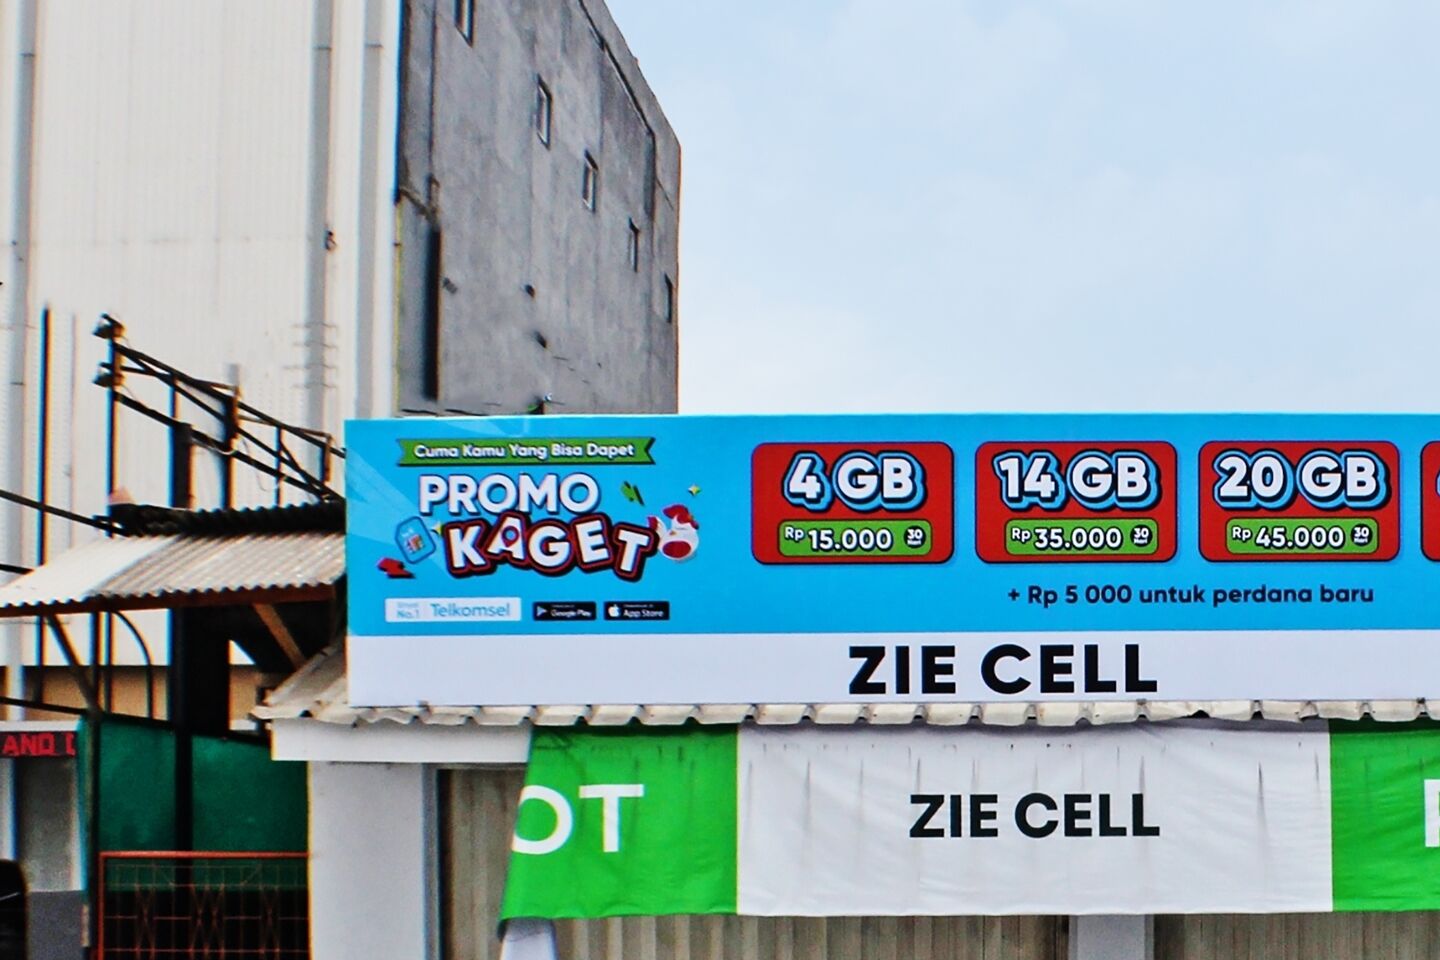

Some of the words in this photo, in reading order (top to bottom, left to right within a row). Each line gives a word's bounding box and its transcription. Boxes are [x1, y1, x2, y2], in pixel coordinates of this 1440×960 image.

[415, 444, 459, 458] Cuma
[463, 444, 505, 458] Kamu
[509, 443, 548, 460] Yang
[552, 443, 583, 457] Bisa
[587, 443, 634, 459] Dapet
[788, 457, 822, 499] 4
[836, 457, 914, 499] GB
[998, 457, 1057, 498] 14
[1071, 457, 1148, 498] GB
[1219, 456, 1285, 497] 20
[1301, 457, 1378, 497] GB
[418, 473, 600, 514] PROMO
[784, 526, 804, 542] Rp
[809, 528, 893, 550] 15.000
[906, 527, 923, 539] 30
[1012, 526, 1031, 542] Rp
[1035, 528, 1122, 550] 35.000
[1133, 527, 1150, 538] 30
[1232, 526, 1251, 542] Rp
[1255, 527, 1345, 548] 45.000
[1353, 526, 1369, 537] 30
[449, 515, 651, 573] KAGET
[1028, 585, 1058, 608] Rp
[1139, 584, 1206, 604] untuk
[1213, 584, 1312, 608] perdana
[1320, 583, 1374, 603] baru
[430, 602, 511, 618] Telkomsel
[623, 608, 640, 619] App
[641, 608, 665, 618] Store
[849, 645, 956, 695] ZIE
[981, 643, 1158, 695] CELL
[909, 793, 999, 838] ZIE
[1014, 792, 1161, 838] CELL
